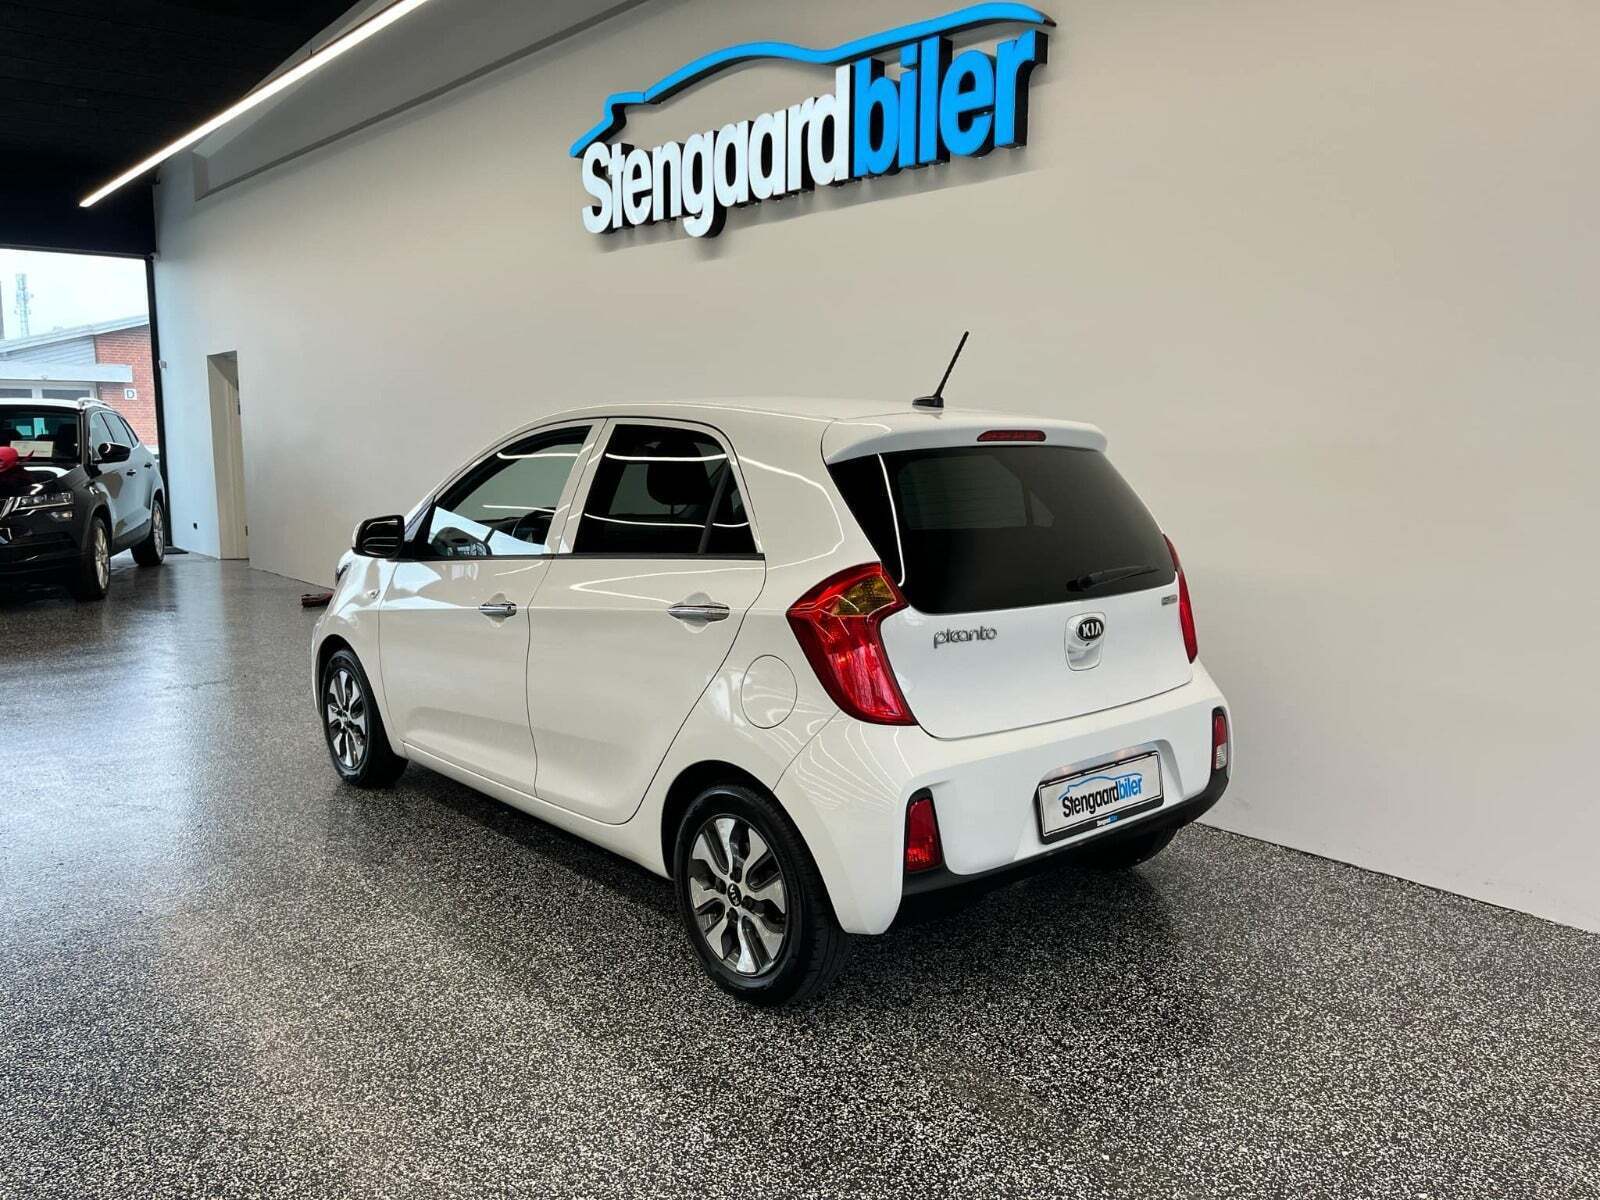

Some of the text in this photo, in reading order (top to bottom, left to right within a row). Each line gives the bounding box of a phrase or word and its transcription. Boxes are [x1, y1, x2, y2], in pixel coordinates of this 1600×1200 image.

[582, 30, 1047, 237] Stengaardbiler
[126, 389, 135, 398] D
[933, 626, 997, 649] picanto
[1081, 621, 1101, 637] KIA
[1062, 776, 1143, 818] Stengaardbiler
